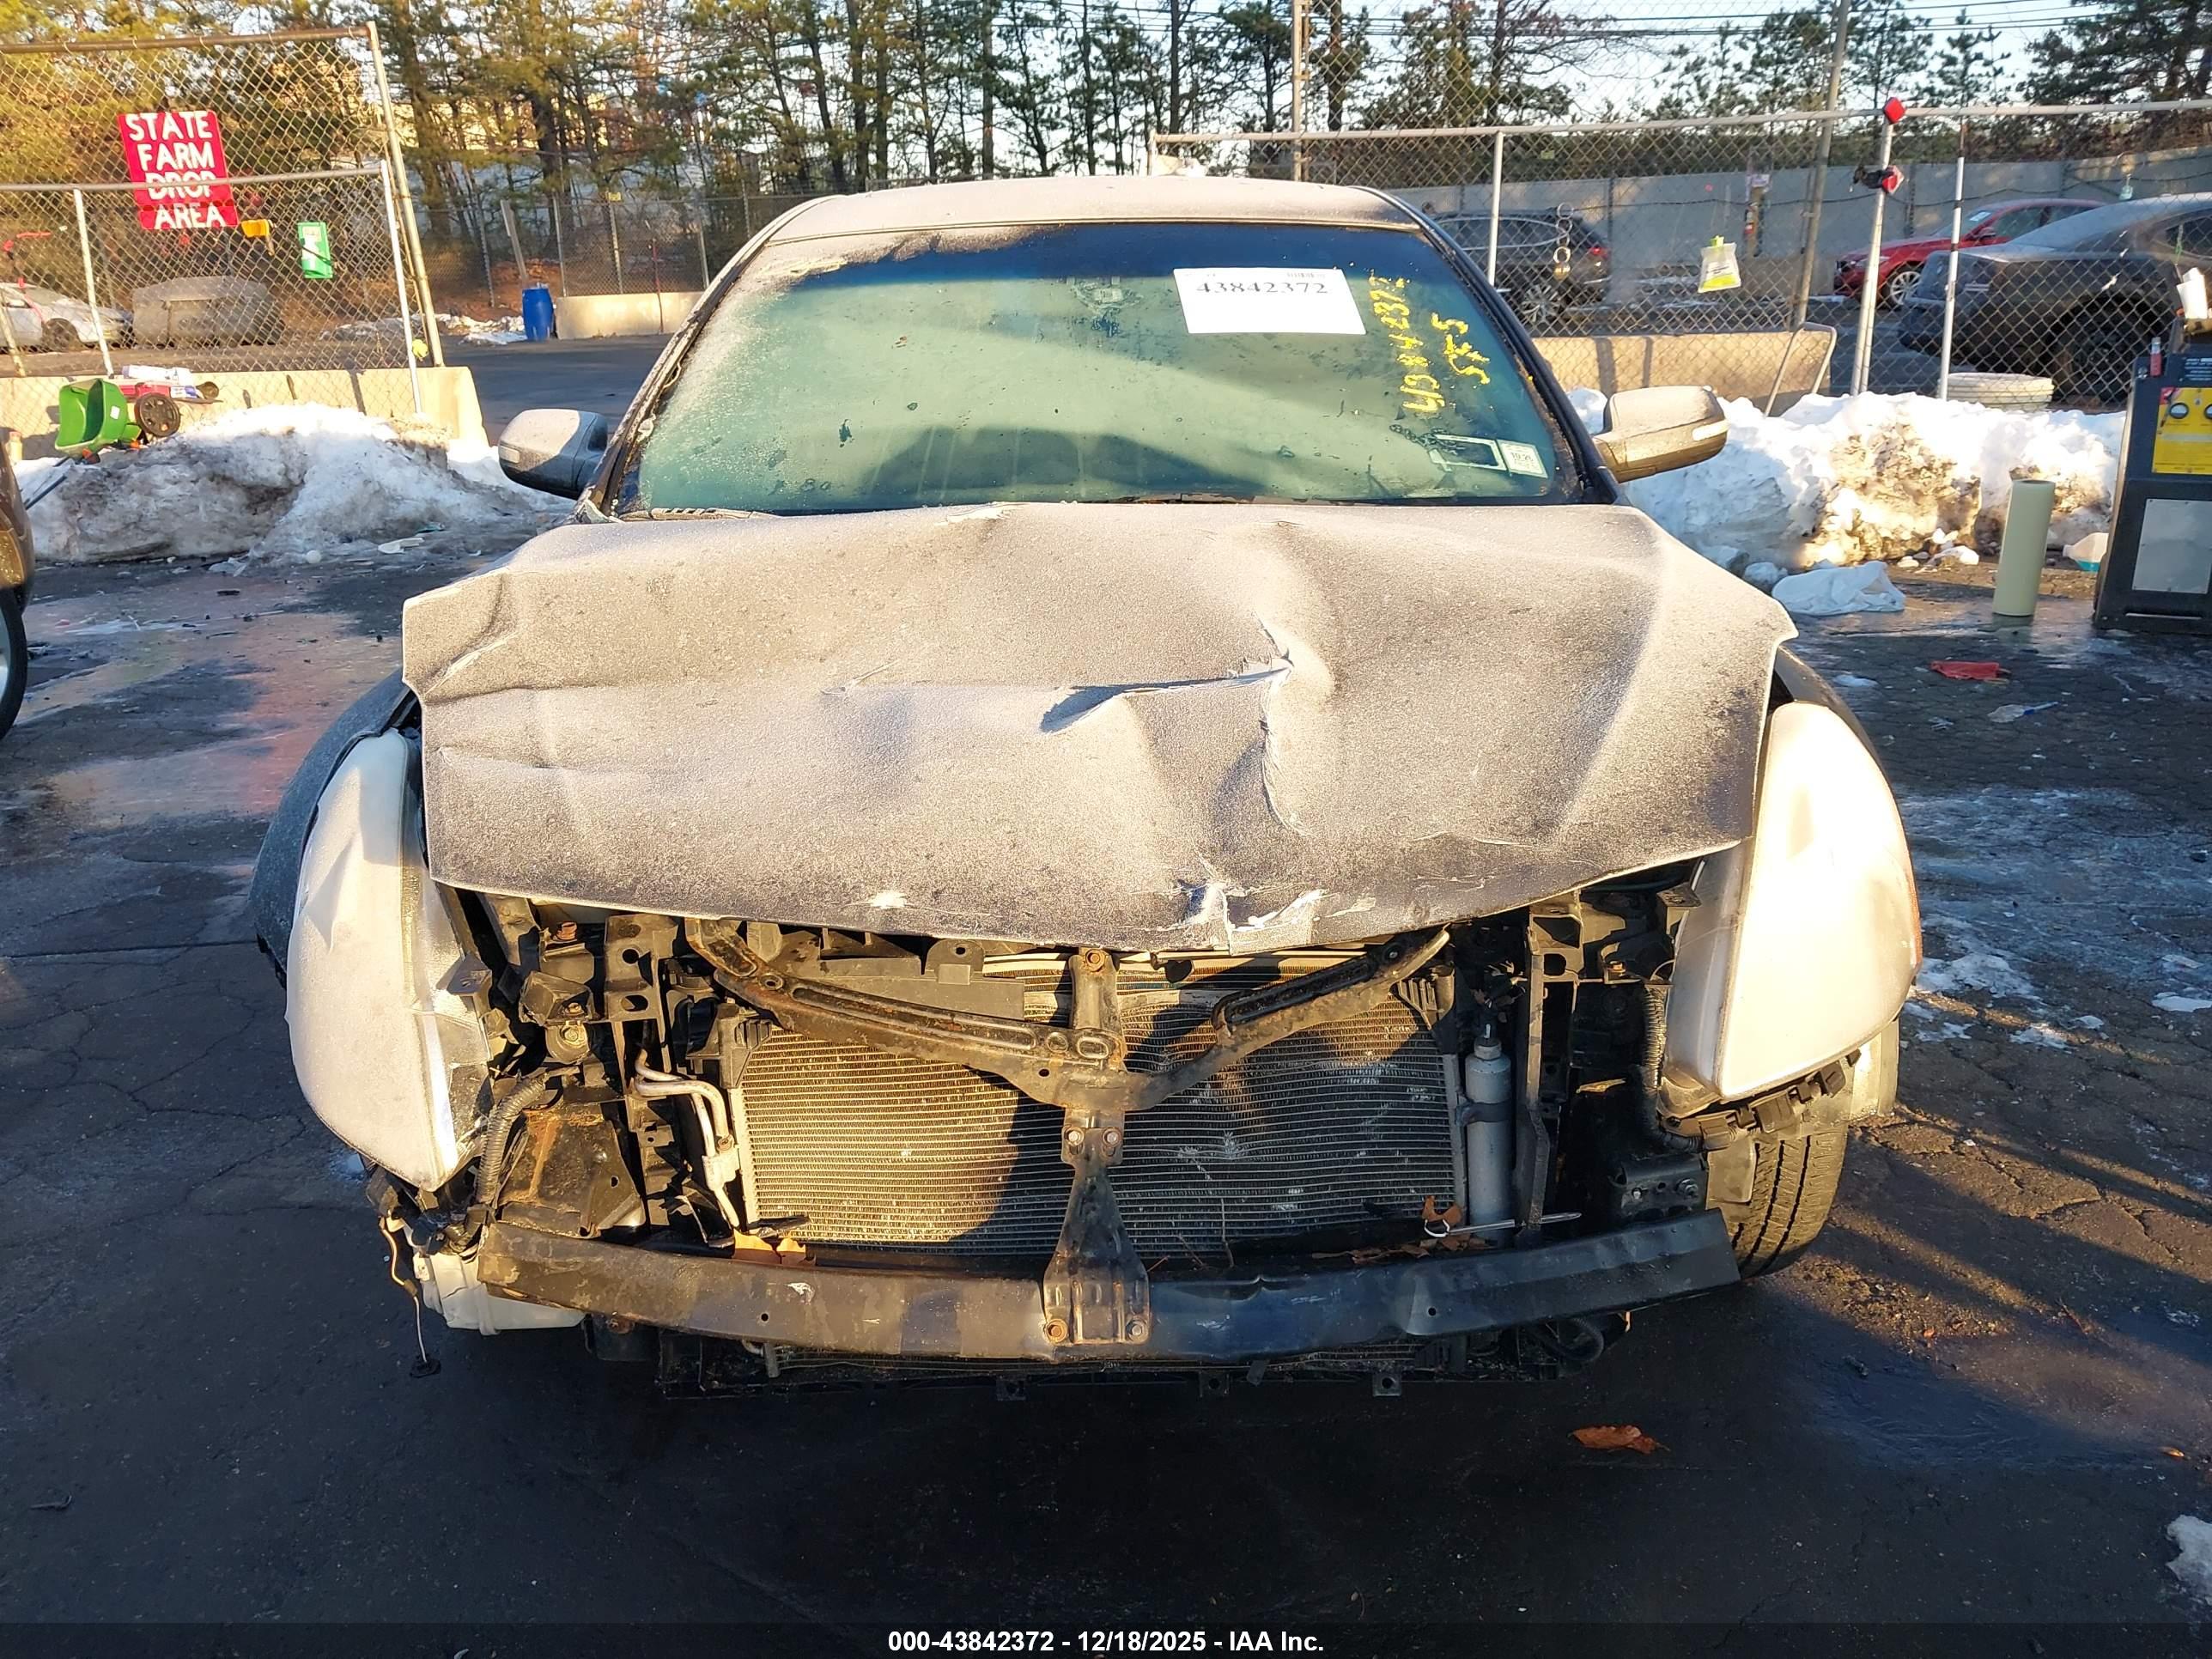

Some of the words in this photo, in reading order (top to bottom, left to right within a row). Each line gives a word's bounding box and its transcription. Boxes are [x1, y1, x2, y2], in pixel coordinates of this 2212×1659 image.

[125, 111, 213, 141] STATE
[137, 142, 215, 171] FARM
[145, 171, 216, 200] DROP
[155, 202, 227, 229] AREA
[1196, 282, 1329, 294] 43842372
